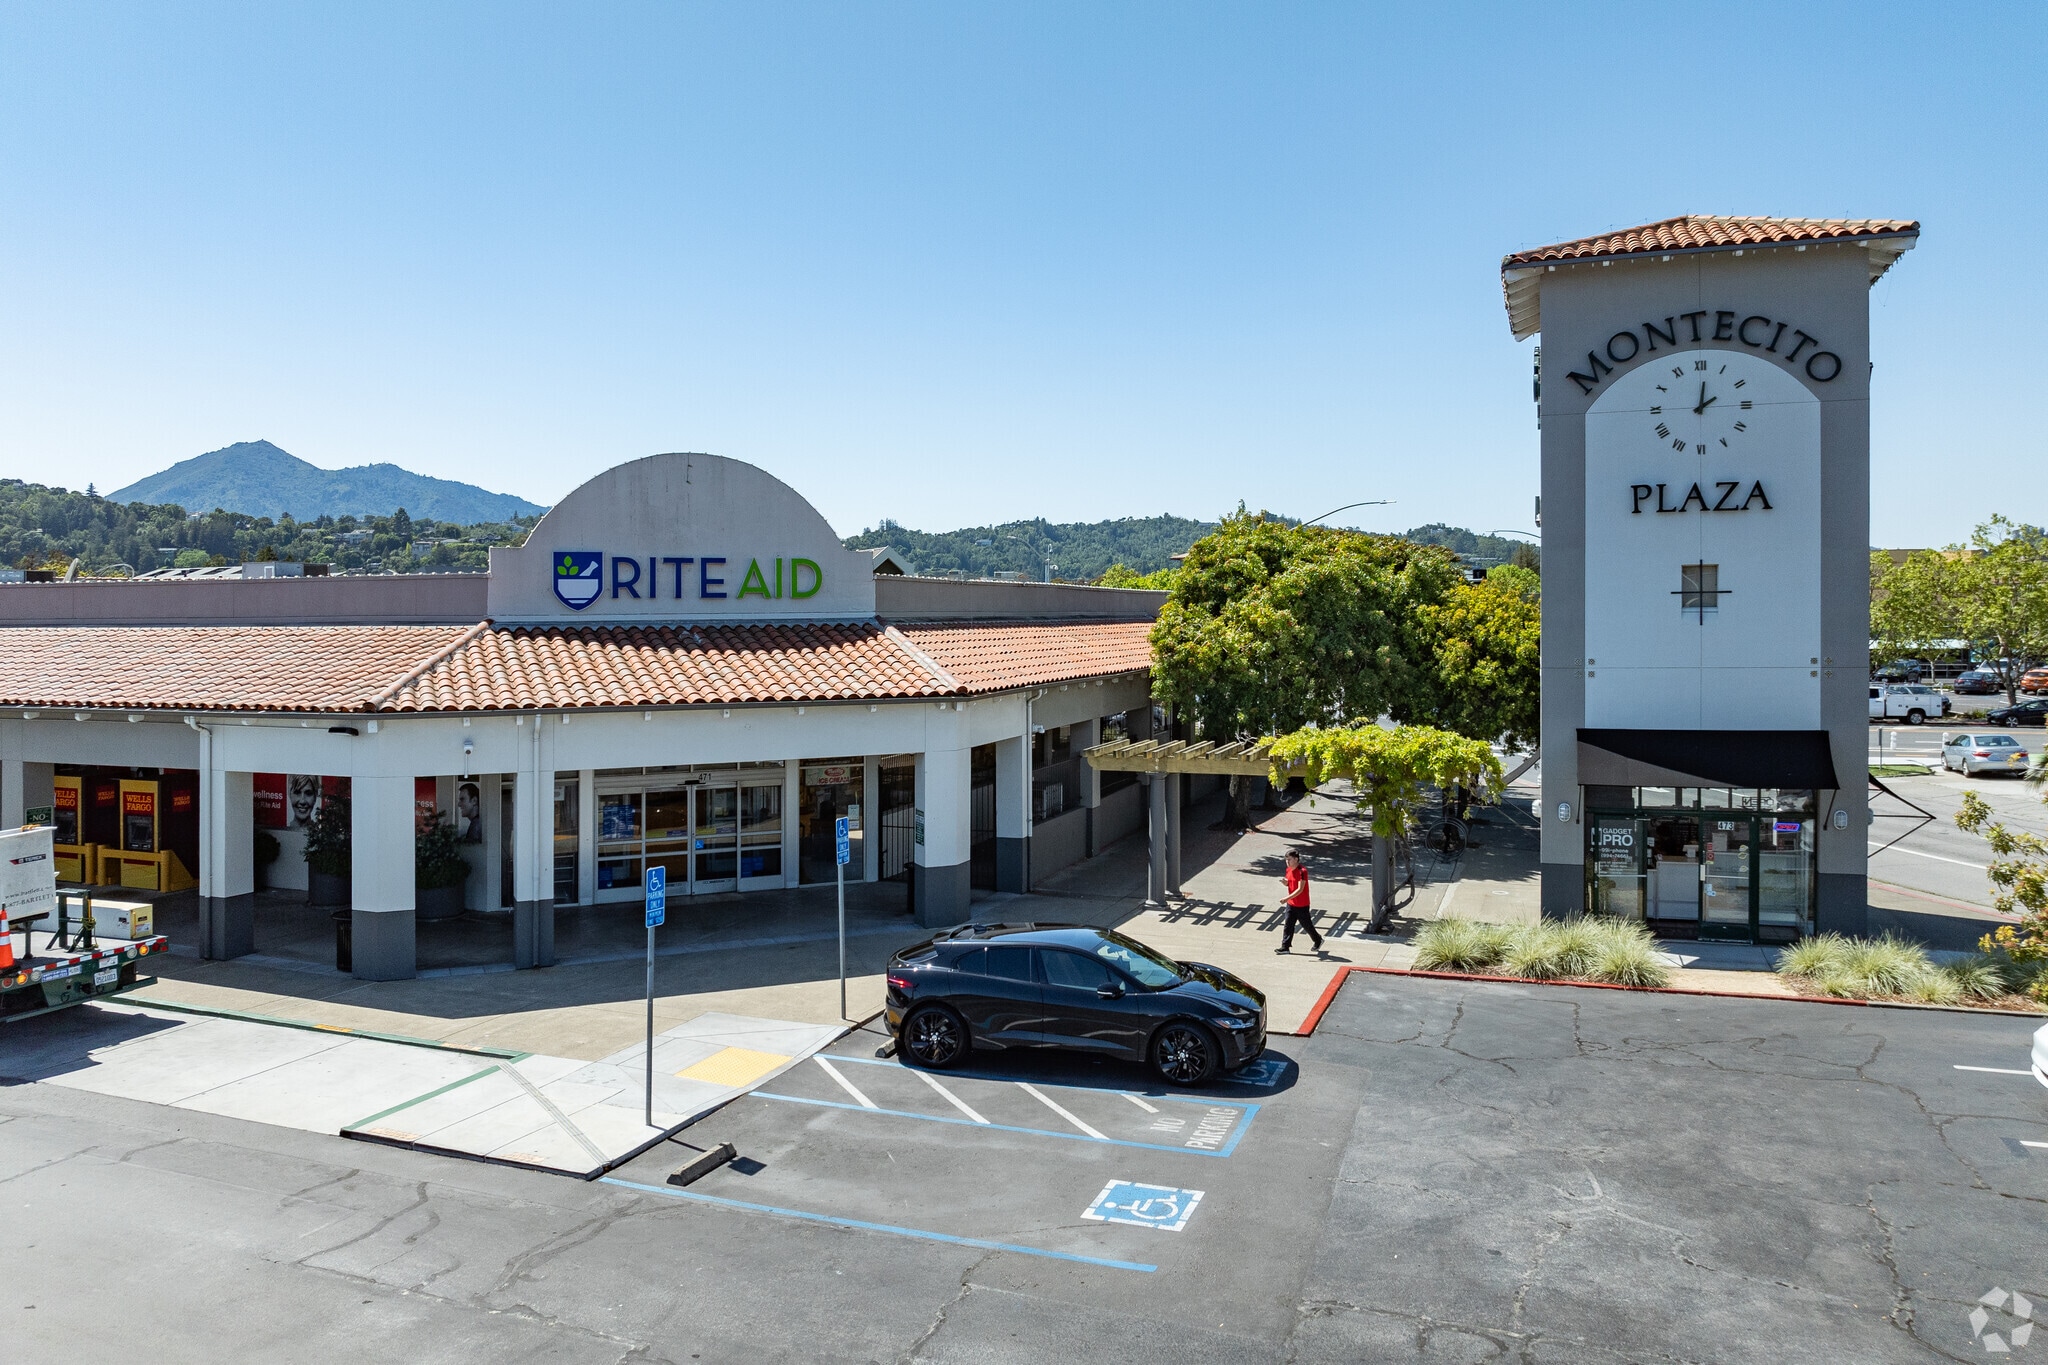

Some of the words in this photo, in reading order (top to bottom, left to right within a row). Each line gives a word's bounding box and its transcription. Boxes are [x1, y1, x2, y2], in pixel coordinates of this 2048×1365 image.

[1565, 310, 1842, 396] MONTECITO
[1694, 360, 1707, 371] XII
[1631, 480, 1773, 514] PLAZA
[611, 556, 728, 599] RITE
[737, 557, 823, 599] AID
[698, 772, 711, 781] 471
[56, 798, 76, 807] ARGO
[126, 794, 152, 803] WELLS
[126, 803, 152, 811] FARGO
[1718, 822, 1733, 830] 473
[1602, 834, 1633, 847] PRO
[647, 889, 664, 900] PARKING
[650, 899, 661, 910] ONLY
[1149, 1117, 1186, 1133] NO
[1185, 1107, 1239, 1150] PARKING
